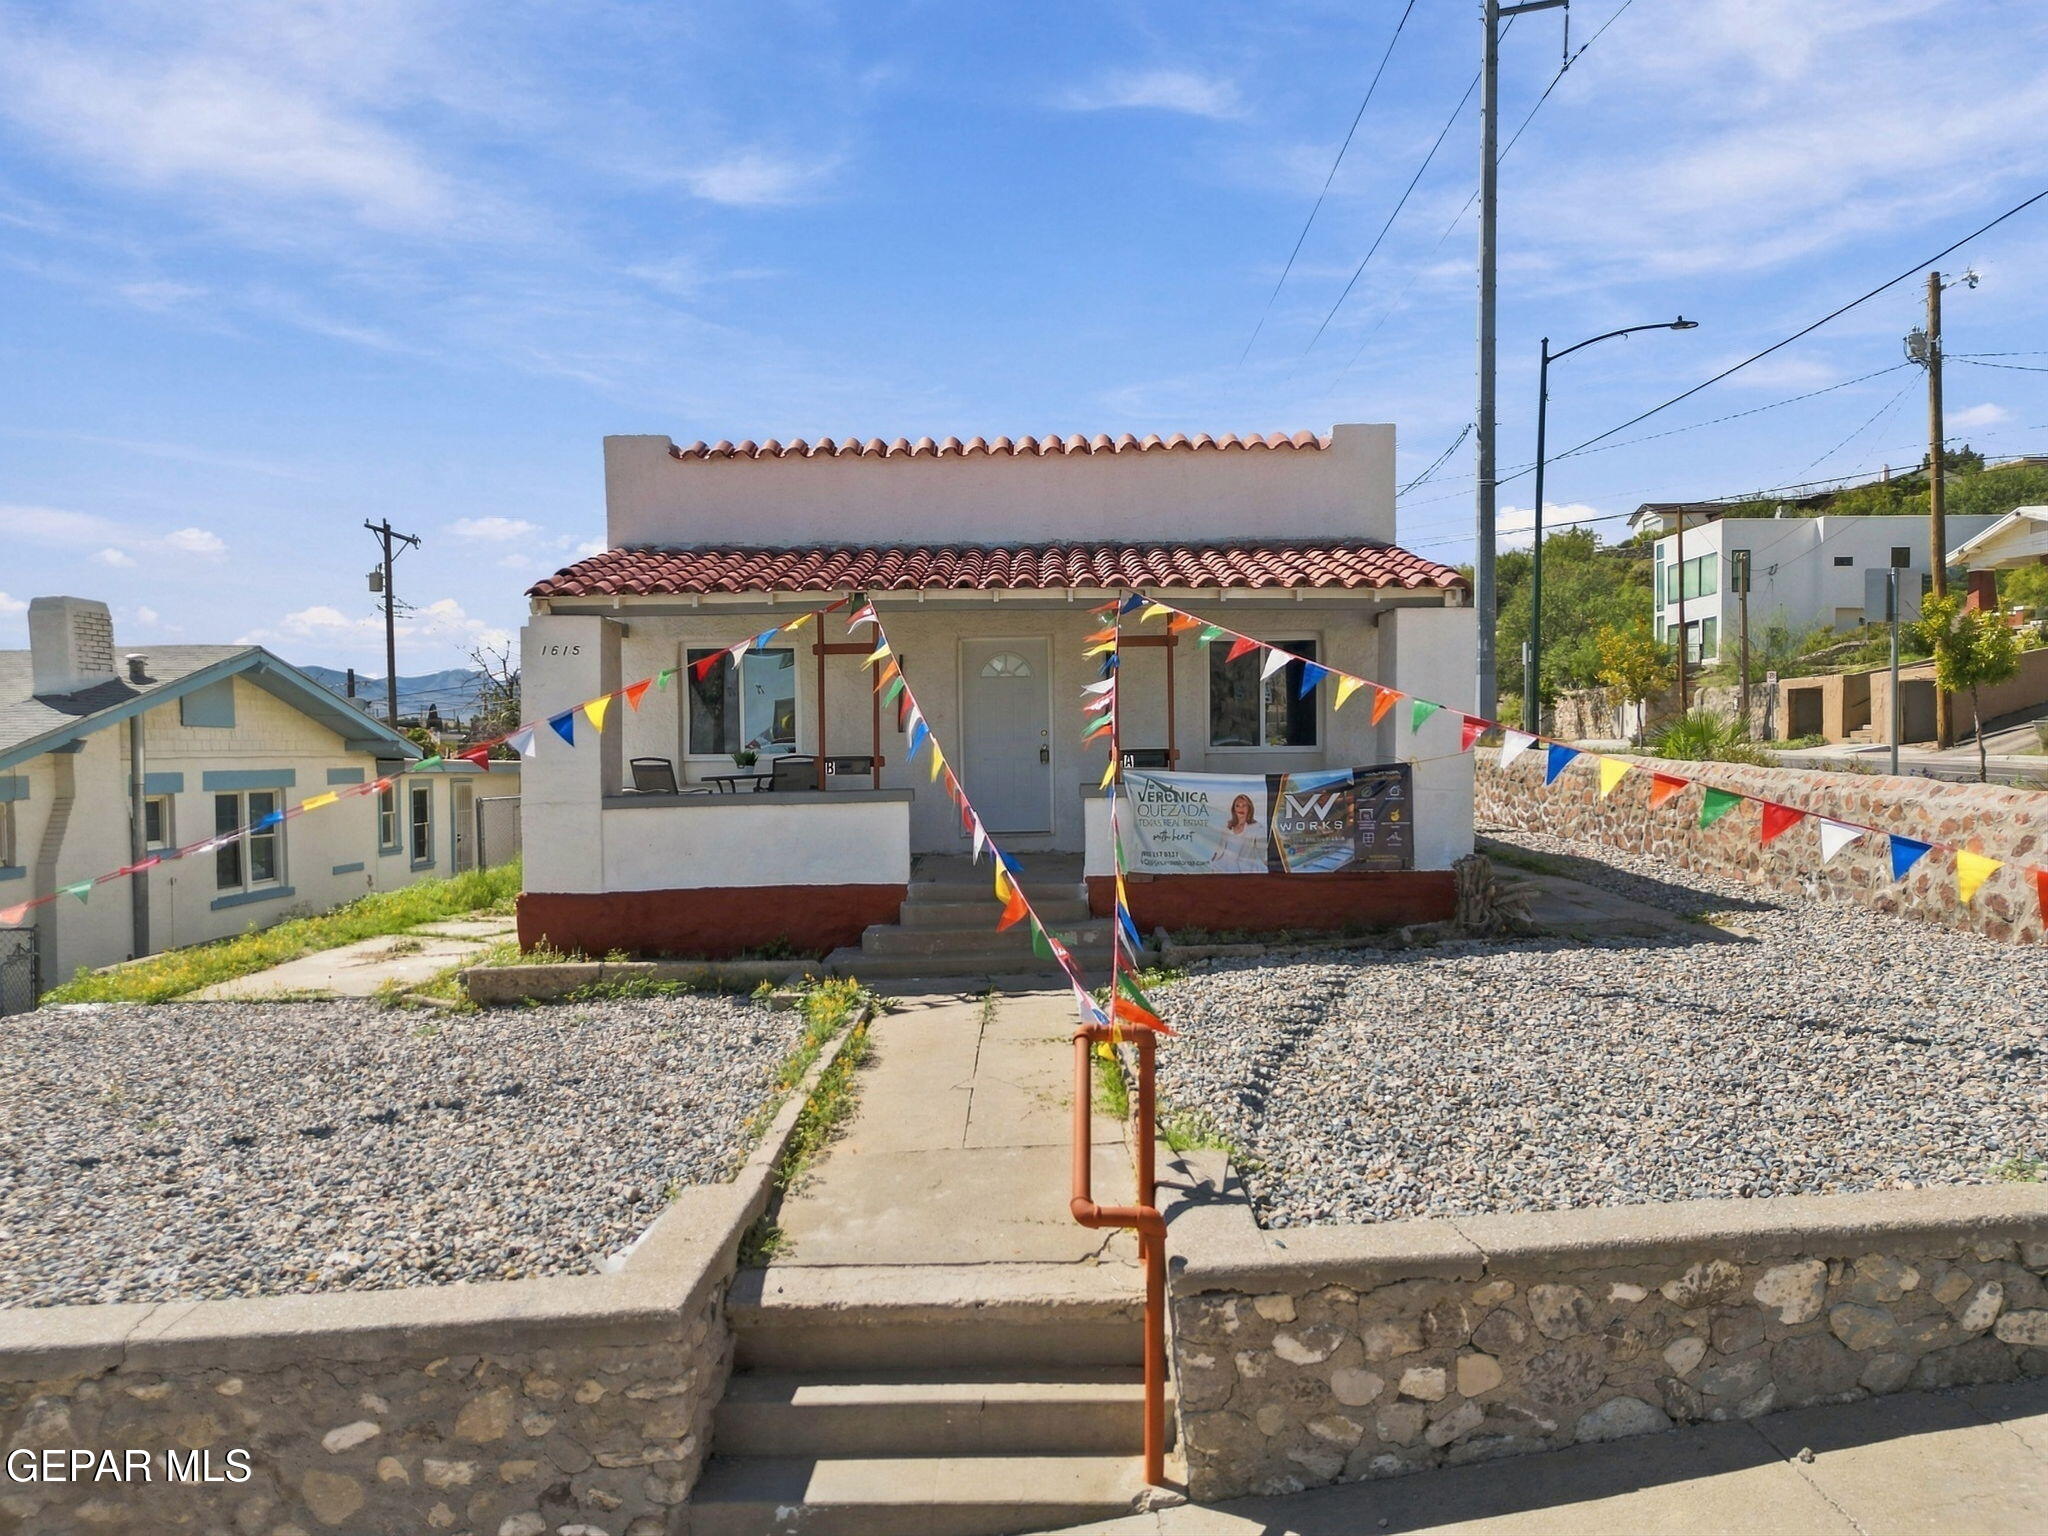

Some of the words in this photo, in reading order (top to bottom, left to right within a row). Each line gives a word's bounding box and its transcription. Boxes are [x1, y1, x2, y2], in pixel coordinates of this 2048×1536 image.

[541, 645, 581, 656] 1615
[826, 761, 834, 775] B
[1123, 754, 1134, 768] A
[1137, 803, 1209, 818] QUEZADA
[1280, 820, 1343, 832] WORKS
